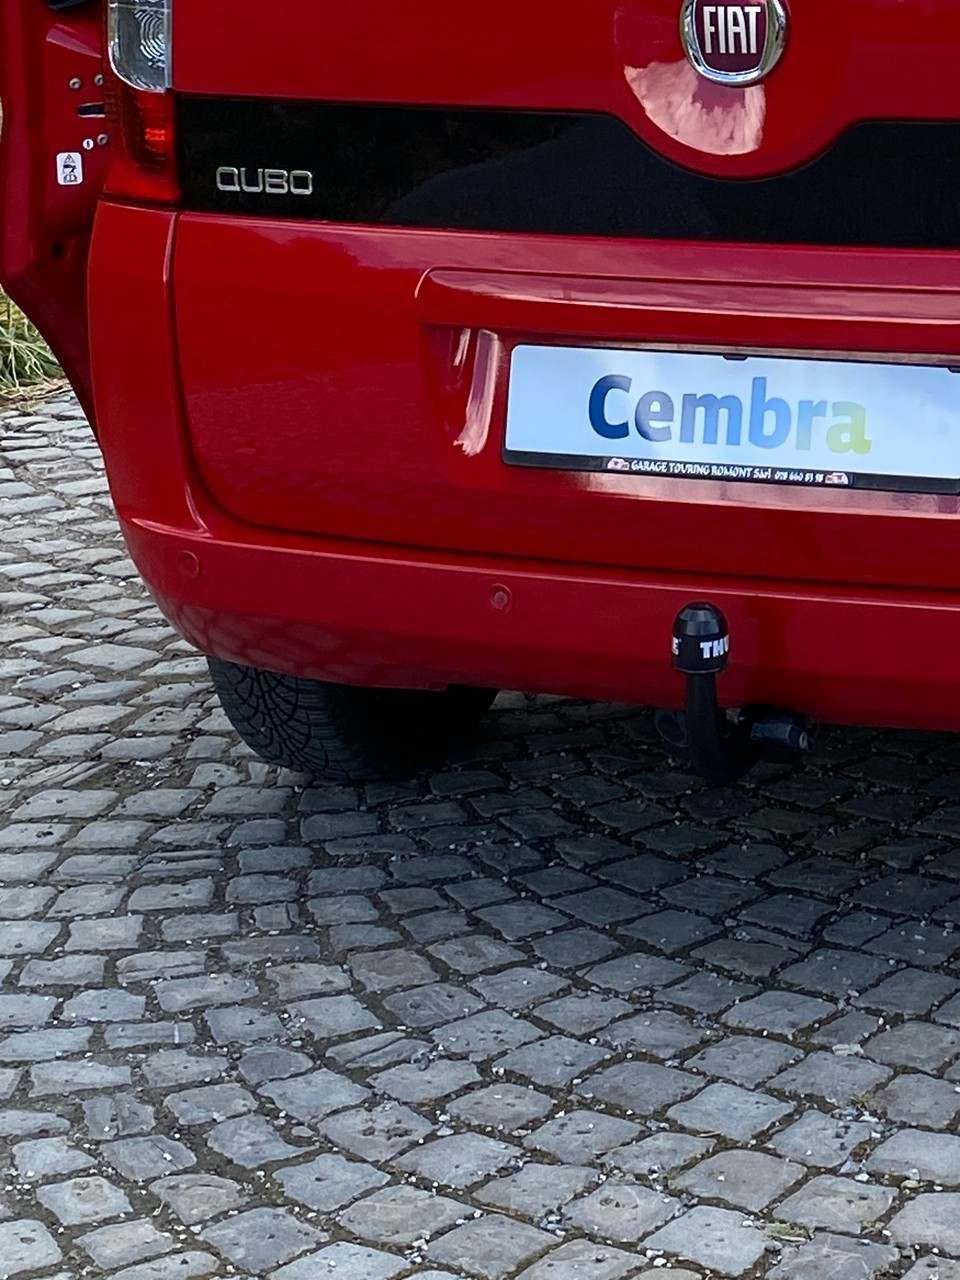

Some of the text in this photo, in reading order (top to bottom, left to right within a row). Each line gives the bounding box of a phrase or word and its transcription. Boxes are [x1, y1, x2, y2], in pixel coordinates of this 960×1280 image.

[703, 6, 762, 54] FIAT
[216, 166, 313, 195] QUBO
[588, 374, 872, 455] Cembra
[631, 460, 667, 473] GARAGE
[669, 462, 710, 475] TOURING
[711, 465, 753, 478] ROMONT
